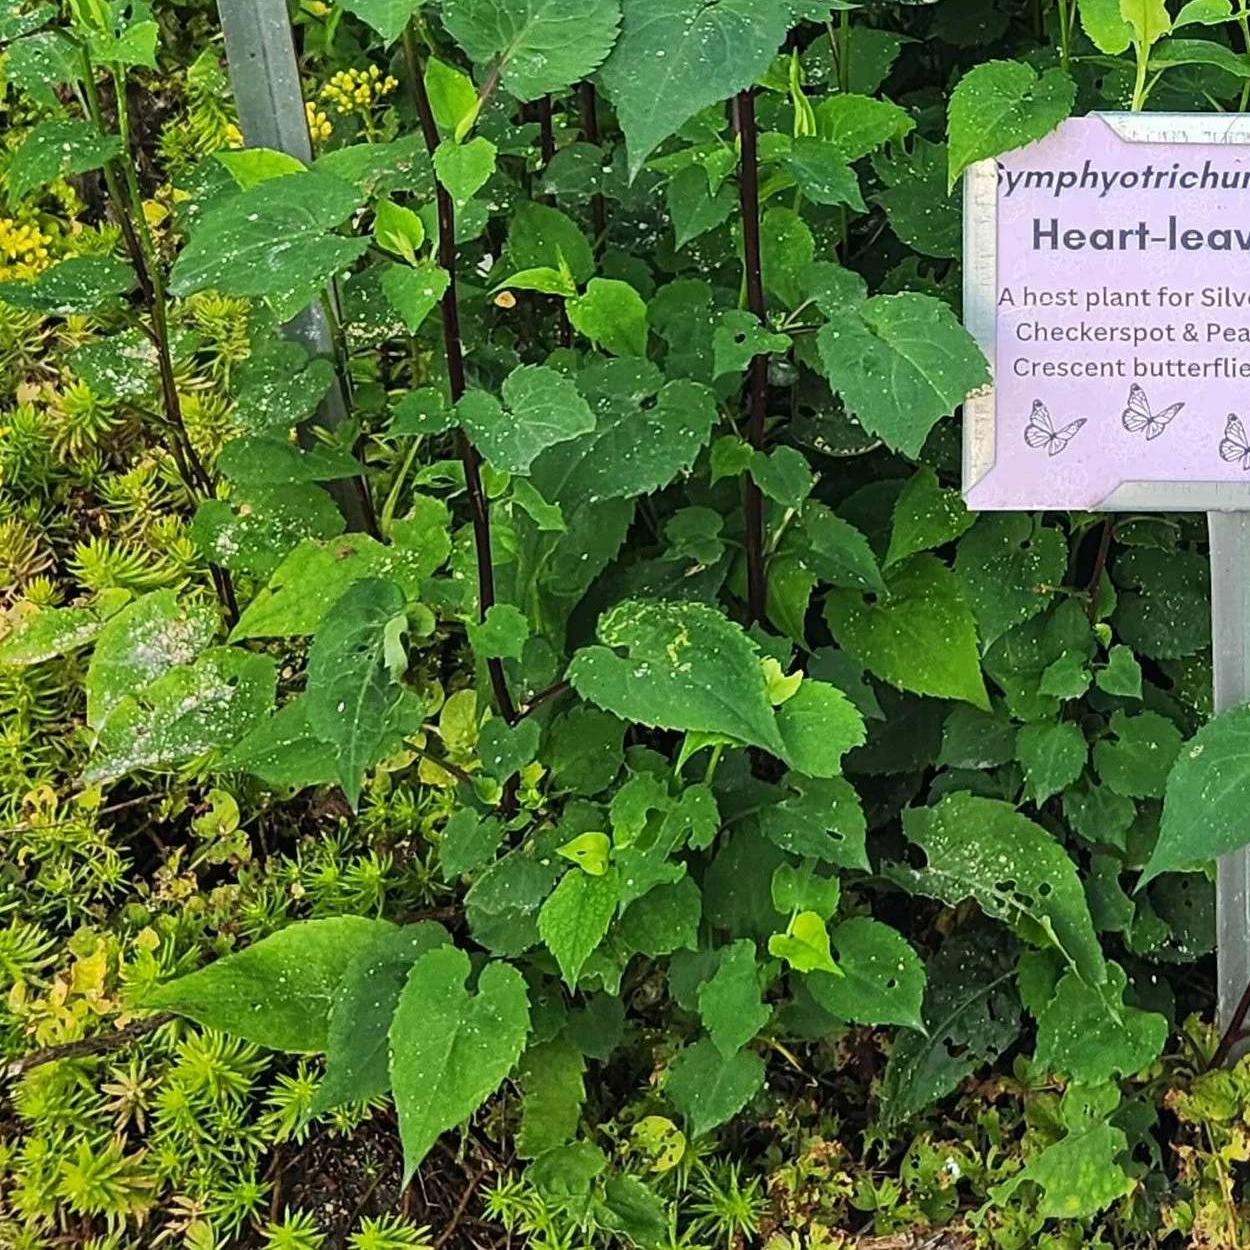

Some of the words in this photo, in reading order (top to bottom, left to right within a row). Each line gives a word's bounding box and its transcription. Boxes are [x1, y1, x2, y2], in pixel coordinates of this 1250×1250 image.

[996, 287, 1015, 307] A
[1023, 286, 1078, 306] host
[1086, 286, 1151, 312] plant
[1157, 286, 1195, 307] for
[1016, 321, 1175, 347] Checkerspot
[1182, 323, 1199, 342] &
[1013, 357, 1126, 377] Crescent
